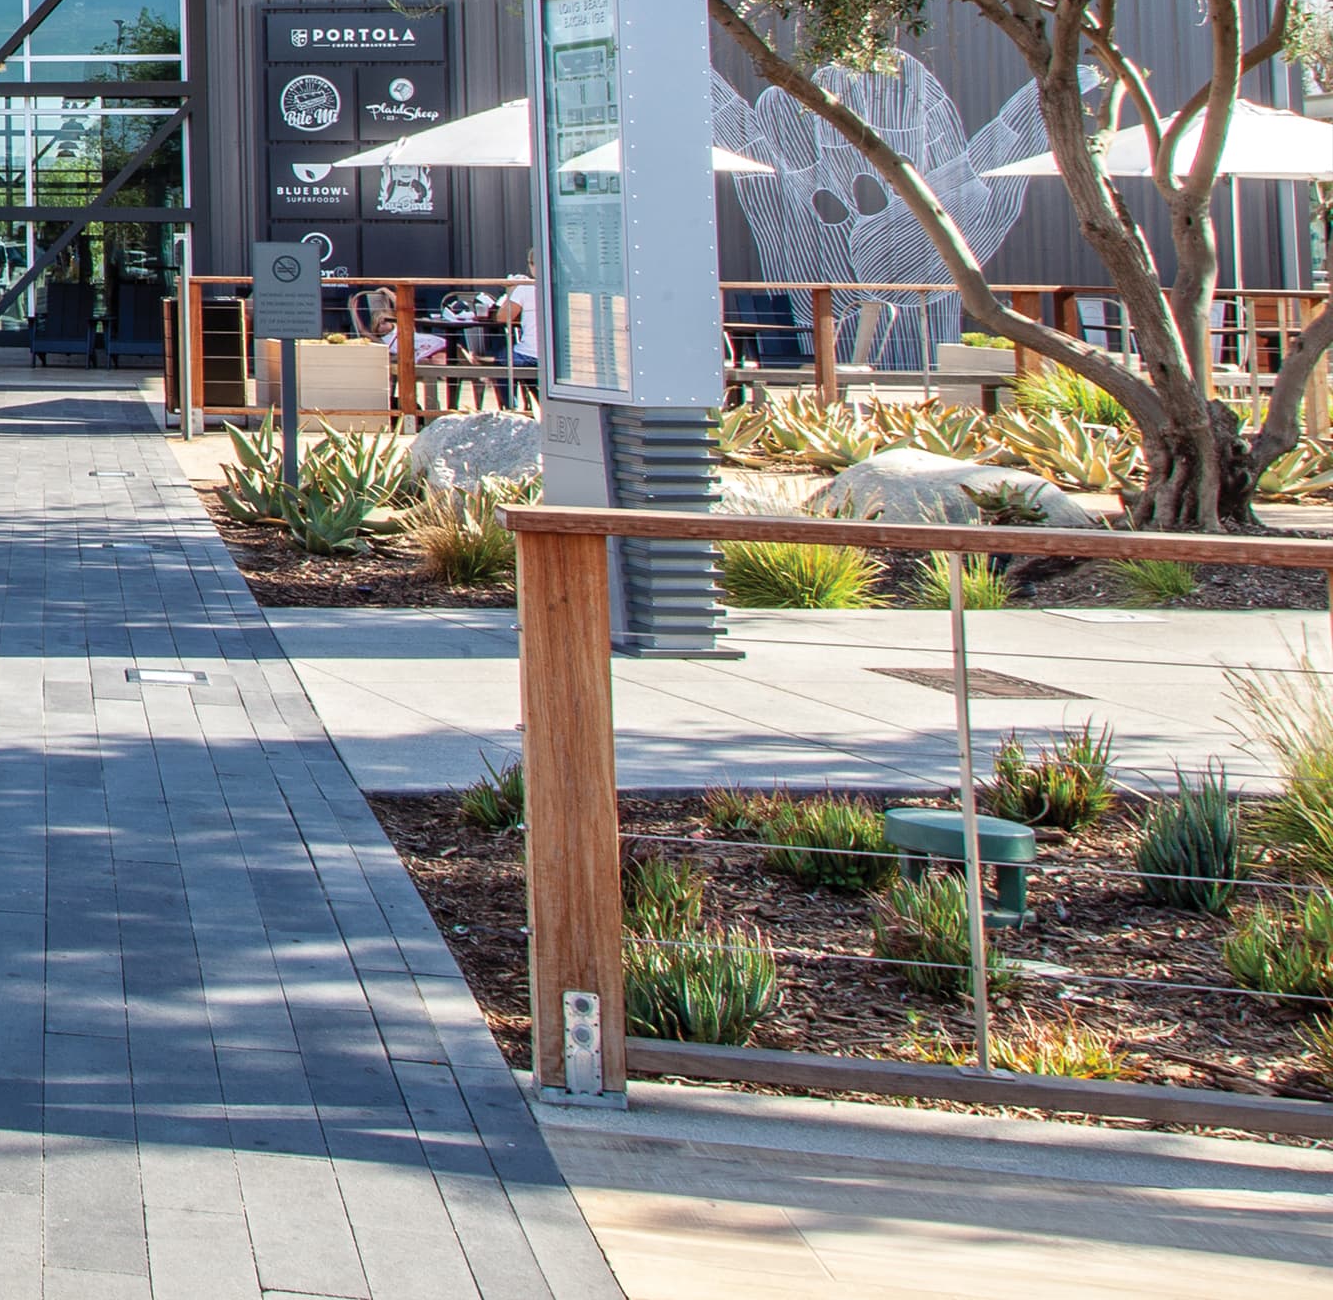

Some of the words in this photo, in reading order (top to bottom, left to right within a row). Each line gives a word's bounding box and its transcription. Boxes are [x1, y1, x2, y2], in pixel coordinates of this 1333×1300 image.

[312, 28, 416, 42] PORTOLA
[284, 111, 313, 126] Bite
[365, 103, 405, 121] Plaid
[404, 107, 440, 121] Sheep
[276, 187, 310, 196] BLUE
[313, 187, 349, 196] BOWL
[546, 413, 581, 446] LBX
